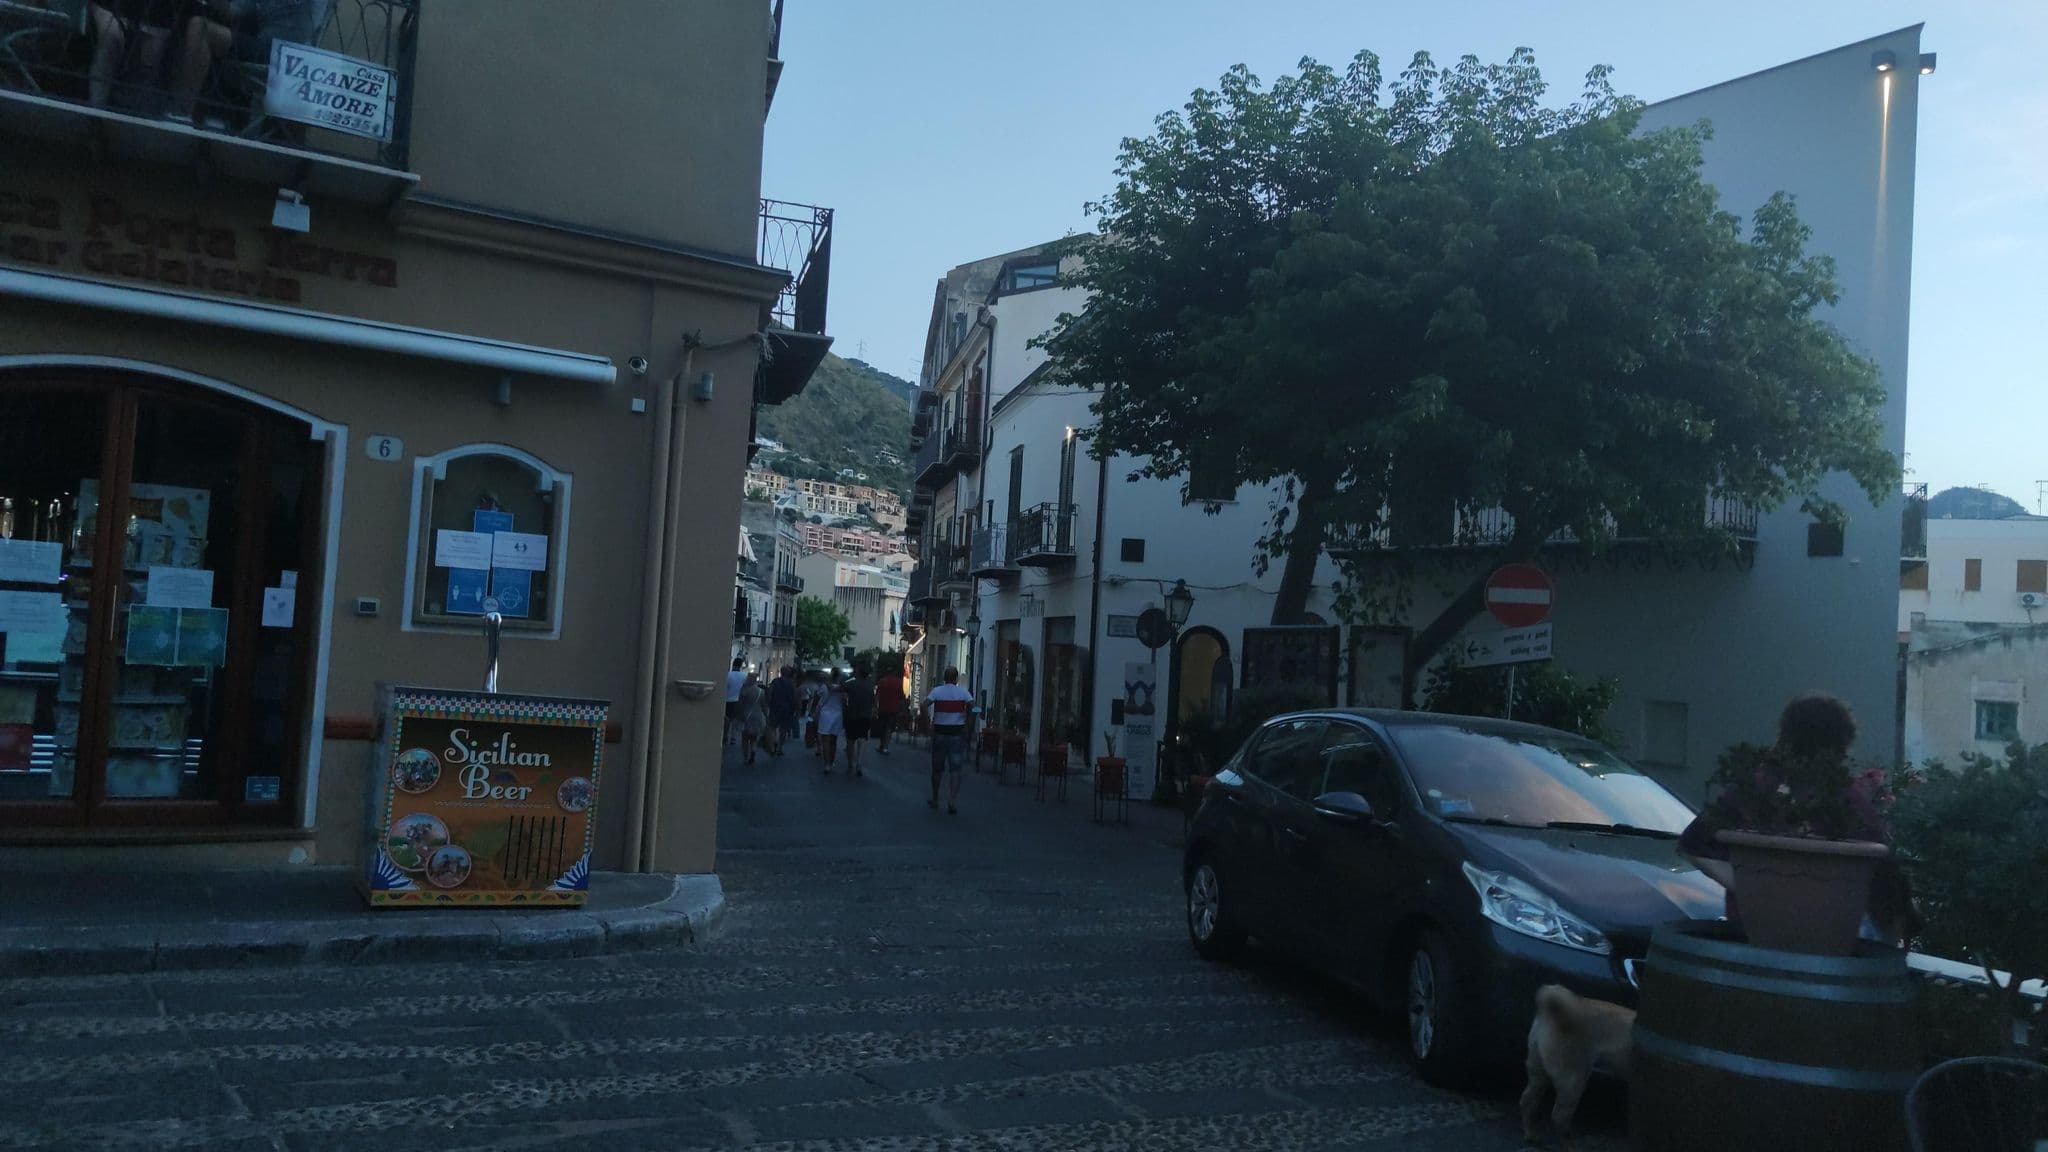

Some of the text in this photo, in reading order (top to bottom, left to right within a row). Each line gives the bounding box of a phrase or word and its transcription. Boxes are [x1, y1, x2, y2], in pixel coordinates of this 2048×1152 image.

[285, 54, 382, 98] VACANZE
[357, 67, 385, 84] Casa
[297, 81, 378, 118] AMORE
[379, 440, 391, 458] 6
[444, 728, 552, 767] Sicilian
[458, 763, 533, 800] Beer
